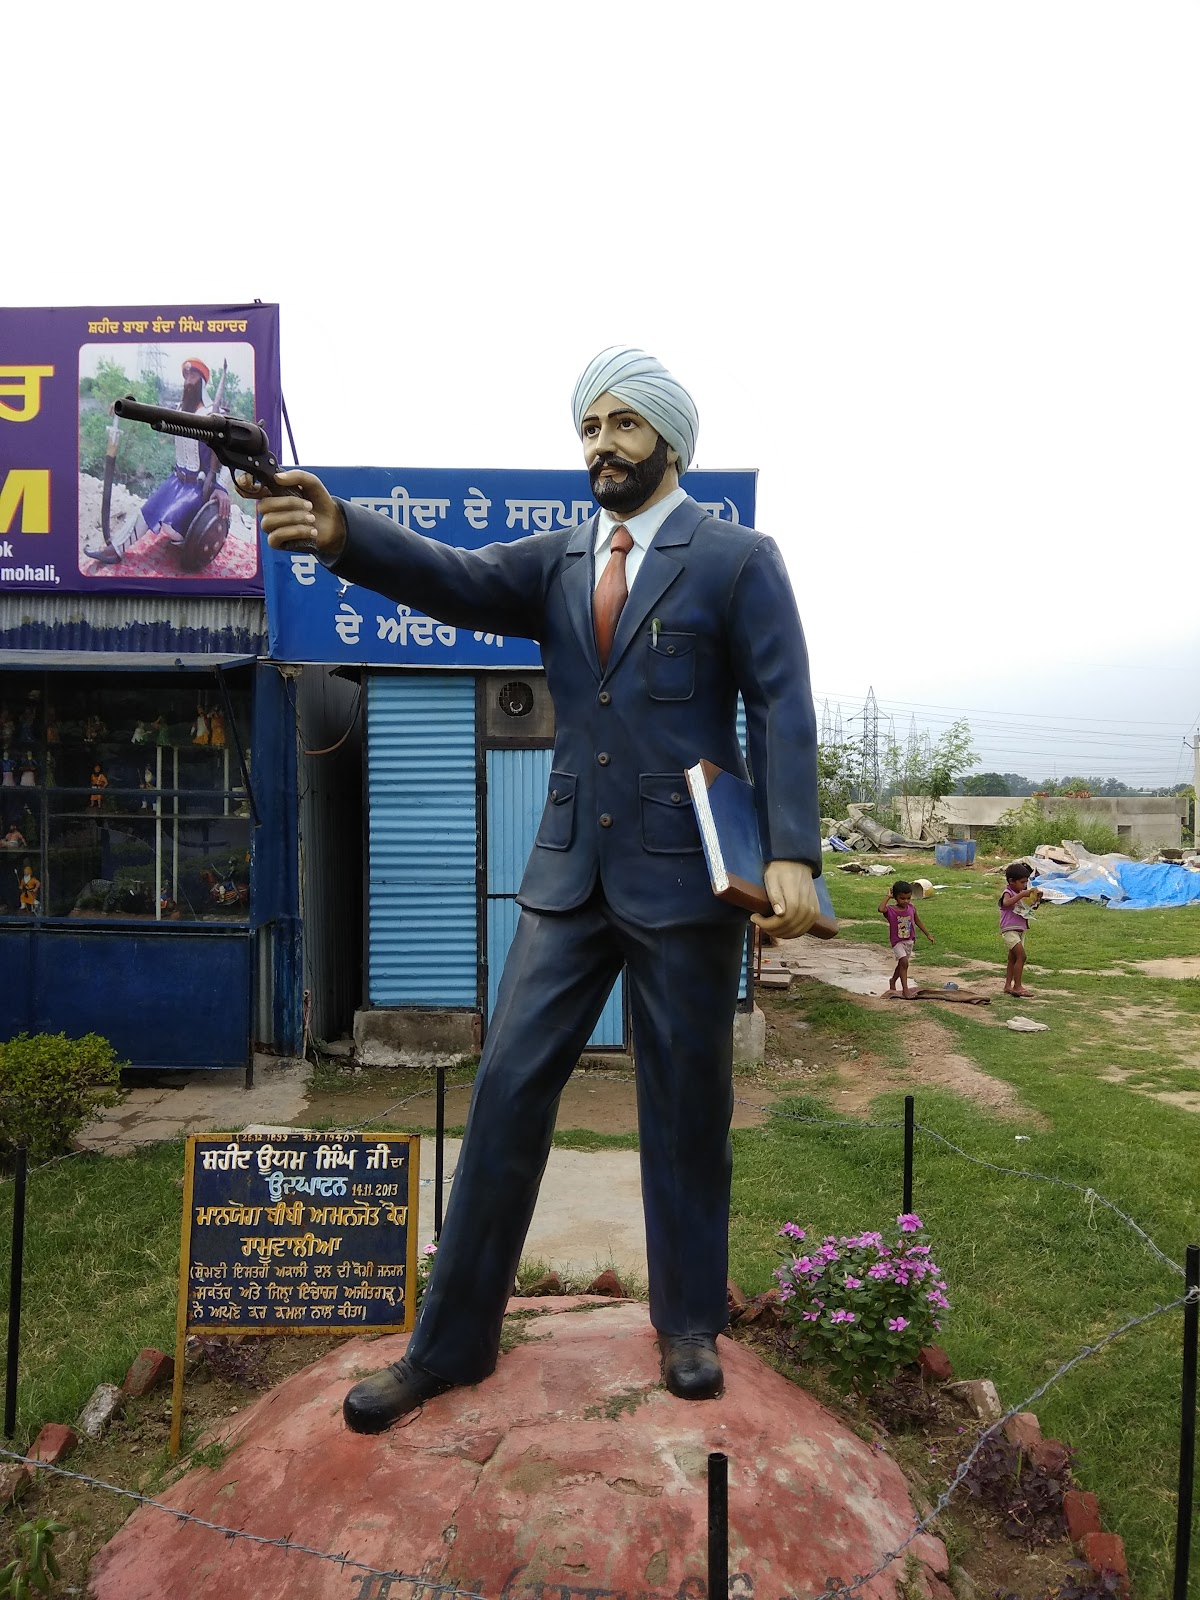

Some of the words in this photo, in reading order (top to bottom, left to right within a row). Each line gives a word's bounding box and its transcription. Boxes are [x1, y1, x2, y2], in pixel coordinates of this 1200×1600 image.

[88, 317, 119, 333] ਸ਼ਹੀਦ
[123, 320, 149, 333] ਬਾਬਾ
[152, 316, 175, 333] ਬੰਦਾ
[179, 315, 204, 332] ਸਿੰਘ
[207, 319, 248, 333] ਬਹਾਦਰ
[464, 487, 491, 529] ਦੇ
[1, 565, 60, 584] mohali,
[335, 603, 364, 645] ਦੇ
[313, 1143, 359, 1170] ਸਿੰਘ
[366, 1143, 392, 1170] ਜੀ
[390, 1157, 404, 1168] ਦਾ
[265, 1201, 306, 1226] ਬੀਬੀ
[274, 1260, 309, 1278] ਅਕਾਲੀ
[314, 1265, 332, 1278] ਦਲ
[337, 1260, 352, 1278] ਦੀ
[239, 1281, 262, 1300] ਅਤੇ
[192, 1301, 204, 1318] ਨੇ
[310, 1305, 335, 1319] ਨਾਲ
